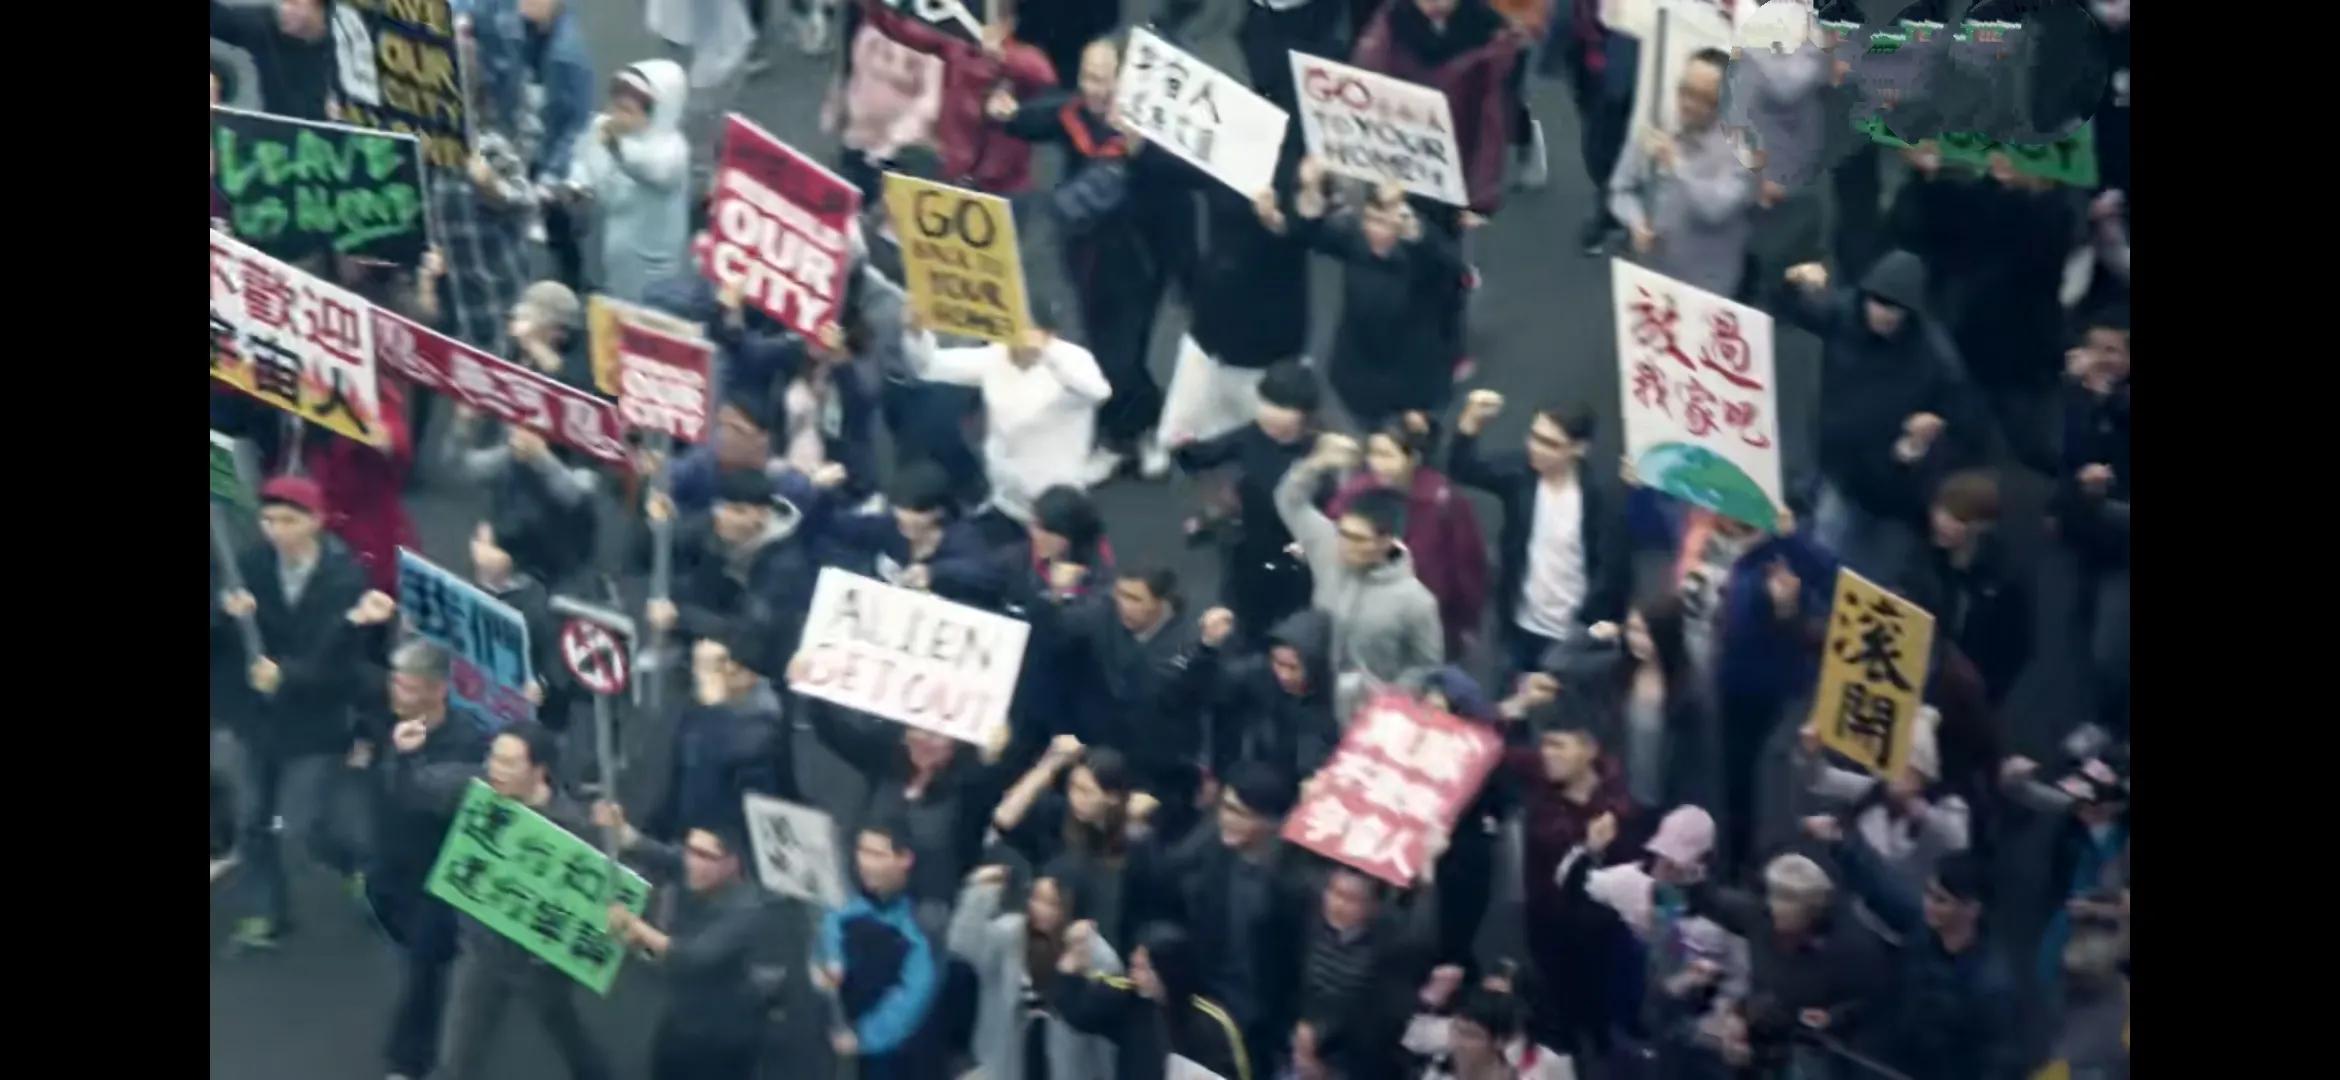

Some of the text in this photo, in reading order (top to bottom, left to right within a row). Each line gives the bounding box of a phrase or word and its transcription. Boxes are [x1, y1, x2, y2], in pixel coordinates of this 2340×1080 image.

[1304, 67, 1374, 113] GO
[719, 197, 838, 304] OUR
[914, 189, 996, 249] GO
[713, 240, 835, 333] CITY
[1630, 283, 1765, 392] 放過
[826, 587, 994, 669] ALIEN
